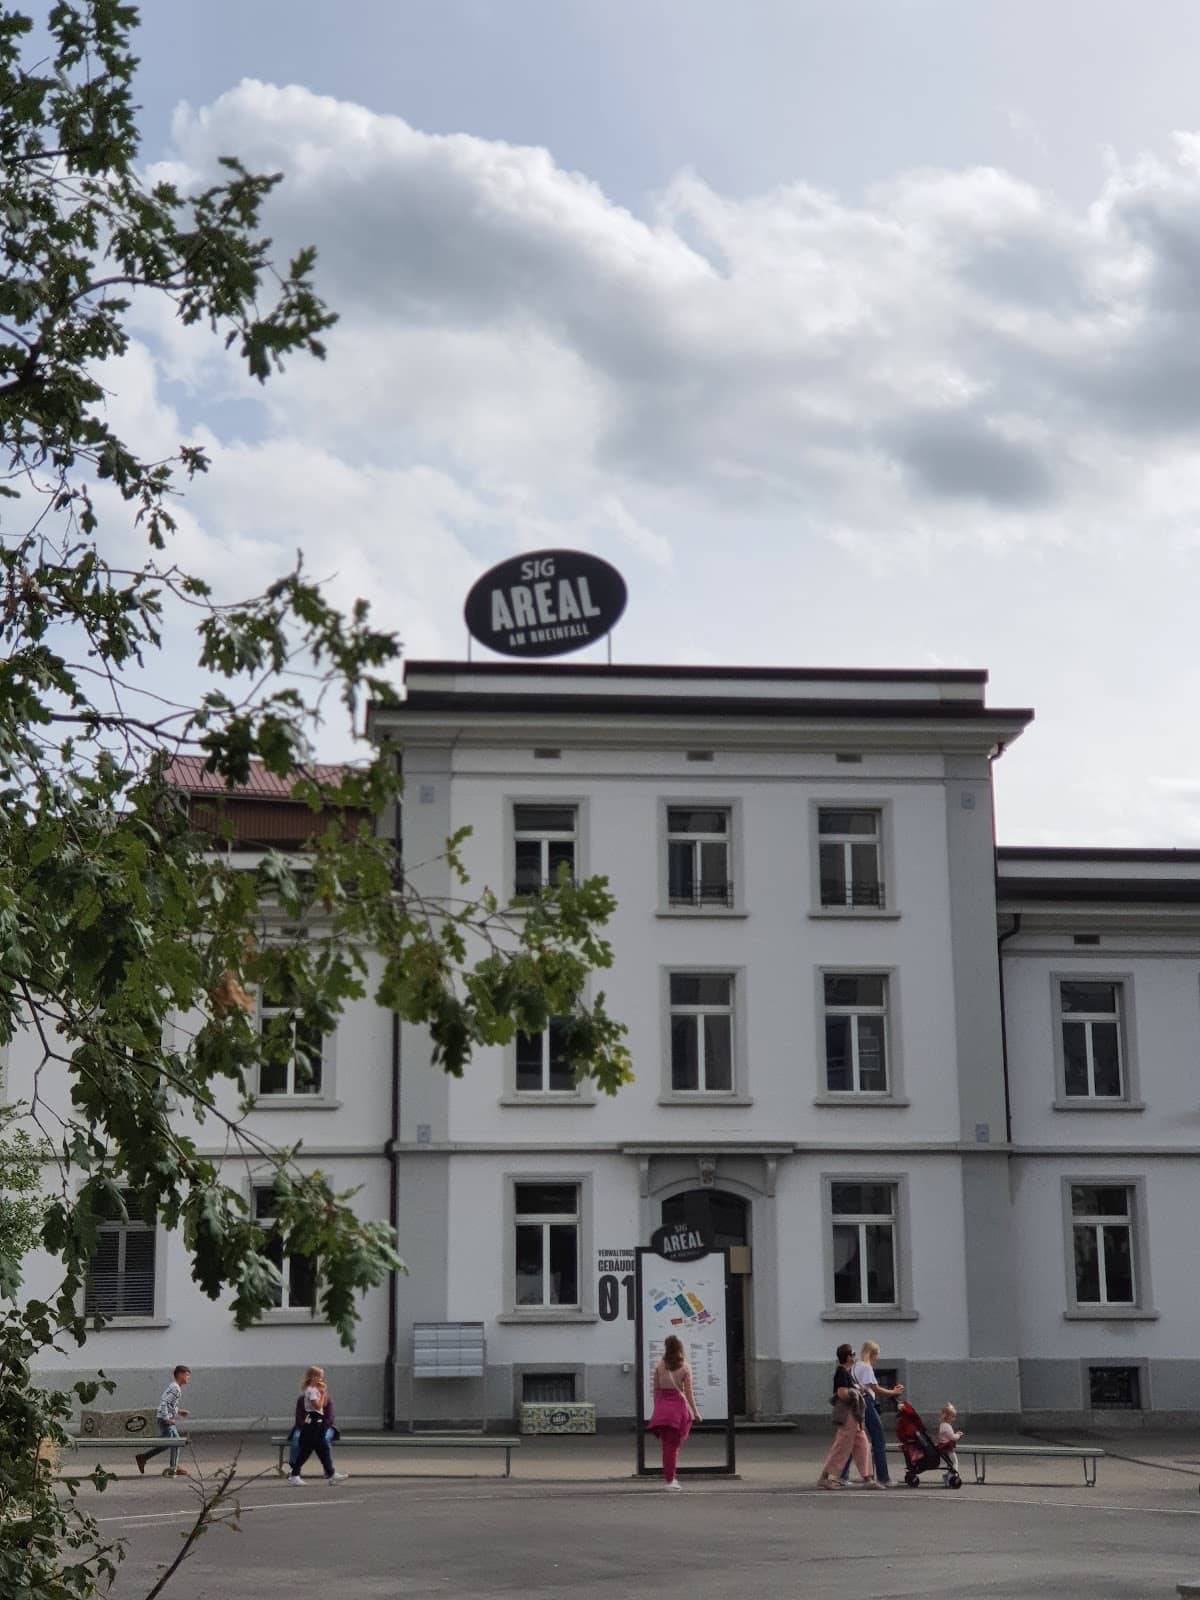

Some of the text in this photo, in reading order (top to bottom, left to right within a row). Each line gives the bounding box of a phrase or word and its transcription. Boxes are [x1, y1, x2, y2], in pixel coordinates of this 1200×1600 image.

[520, 558, 555, 581] SIG
[491, 576, 601, 632] AREAL
[509, 623, 590, 647] AM RHEINFALL
[663, 1230, 704, 1254] AREAL
[598, 1274, 635, 1322] 01
